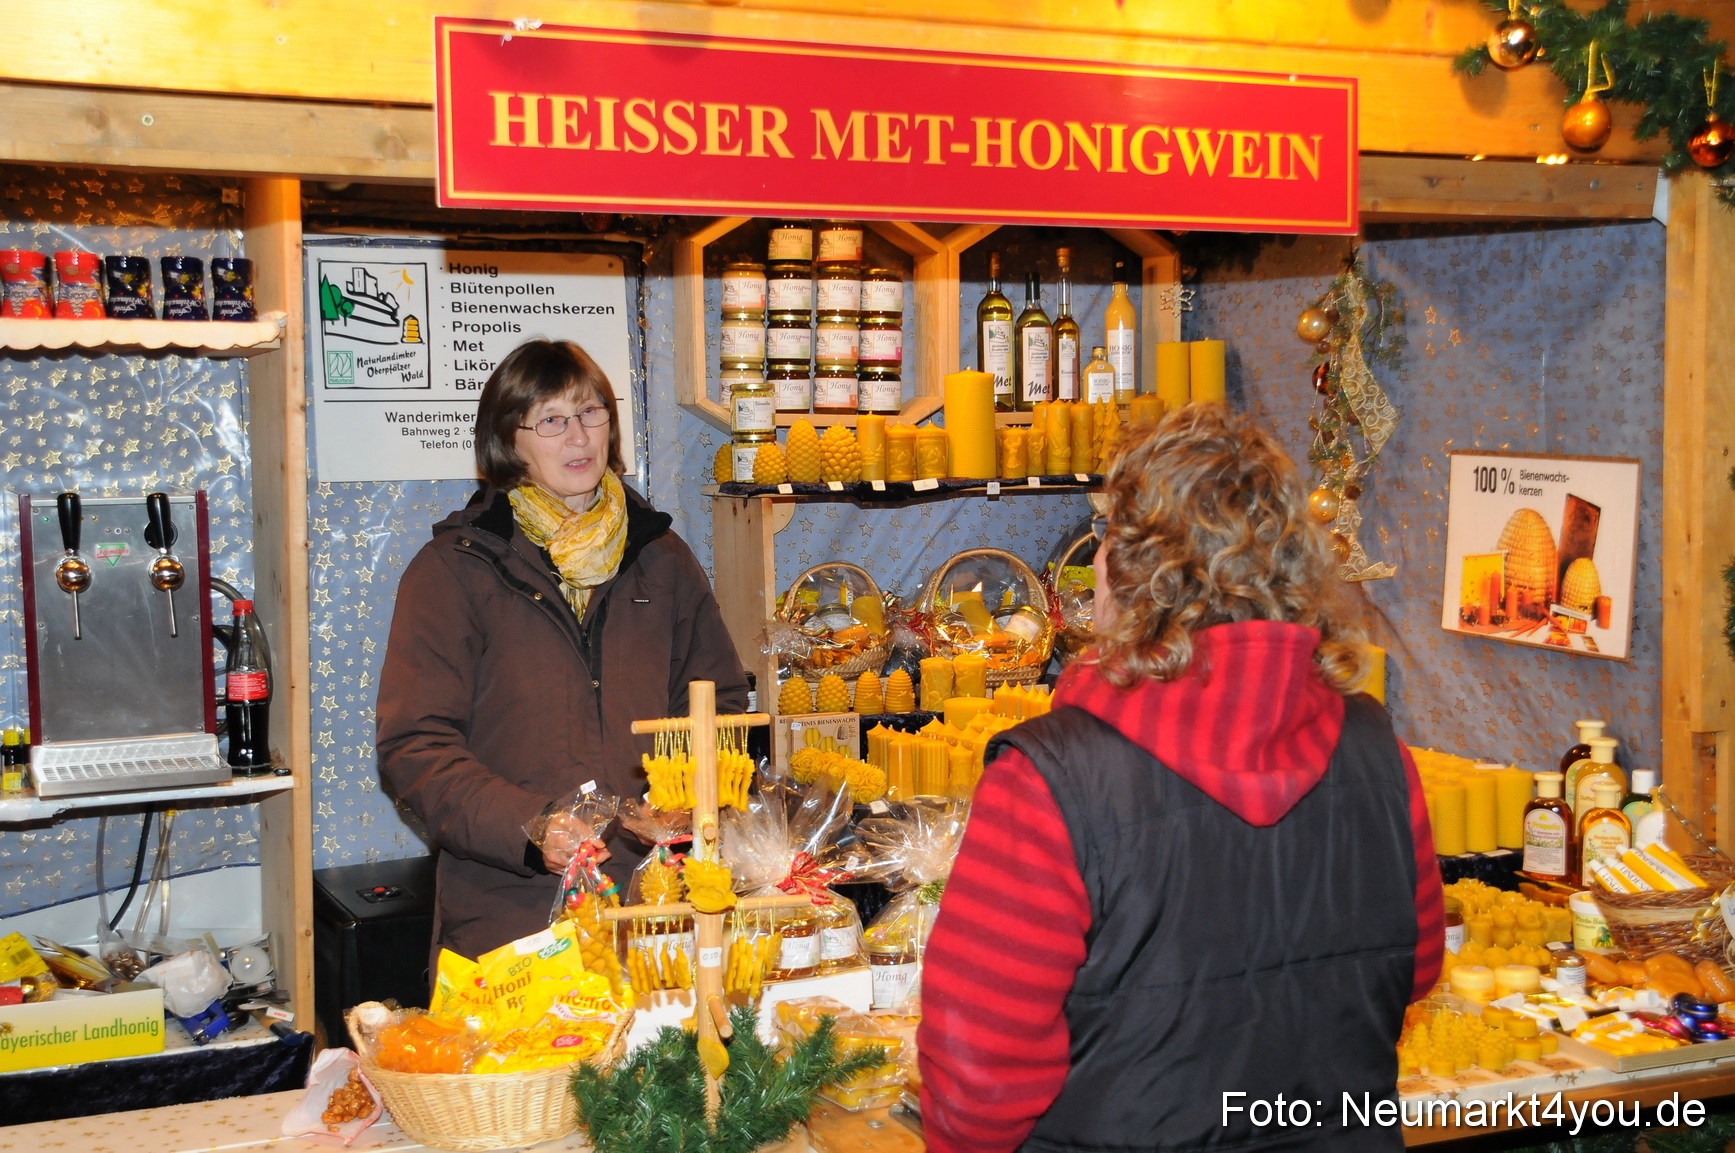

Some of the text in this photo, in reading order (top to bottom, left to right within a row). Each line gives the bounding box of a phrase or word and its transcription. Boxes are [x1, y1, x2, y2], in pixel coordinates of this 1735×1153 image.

[488, 90, 1323, 182] HEISSER MET-HONIGWEIN
[780, 233, 803, 243] Honig
[837, 234, 858, 243] Honig
[449, 262, 499, 278] Honig
[450, 282, 555, 297] Blütenpollen
[742, 281, 763, 292] Honig
[782, 282, 804, 292] Honig
[831, 283, 854, 293] Honig
[874, 285, 896, 295] Honig
[451, 301, 615, 316] Bienenwachskerzen
[452, 320, 522, 336] Propolis
[737, 331, 760, 341] Honig
[779, 332, 801, 342] Honig
[831, 333, 853, 343] Honig
[876, 333, 898, 344] Honig
[453, 340, 485, 352] Met
[356, 350, 417, 368] Naturlandimker
[366, 362, 411, 378] Oberpfälzer
[454, 358, 497, 372] Likör
[401, 371, 424, 383] Wald
[782, 383, 804, 393] Honig
[829, 382, 852, 392] Honig
[875, 385, 896, 395] Honig
[1028, 380, 1051, 397] Met
[385, 412, 477, 423] Wanderimker
[401, 427, 451, 438] Bahnweg
[454, 427, 460, 436] 2
[420, 440, 459, 449] Telefon
[1473, 466, 1515, 495] 100 %
[1519, 469, 1570, 483] Bienenwachs-
[1519, 485, 1543, 497] kerzen
[817, 717, 856, 726] BIENENWACHS
[508, 957, 532, 976] BIO
[876, 971, 908, 983] Honig
[84, 1016, 159, 1041] Landhonig
